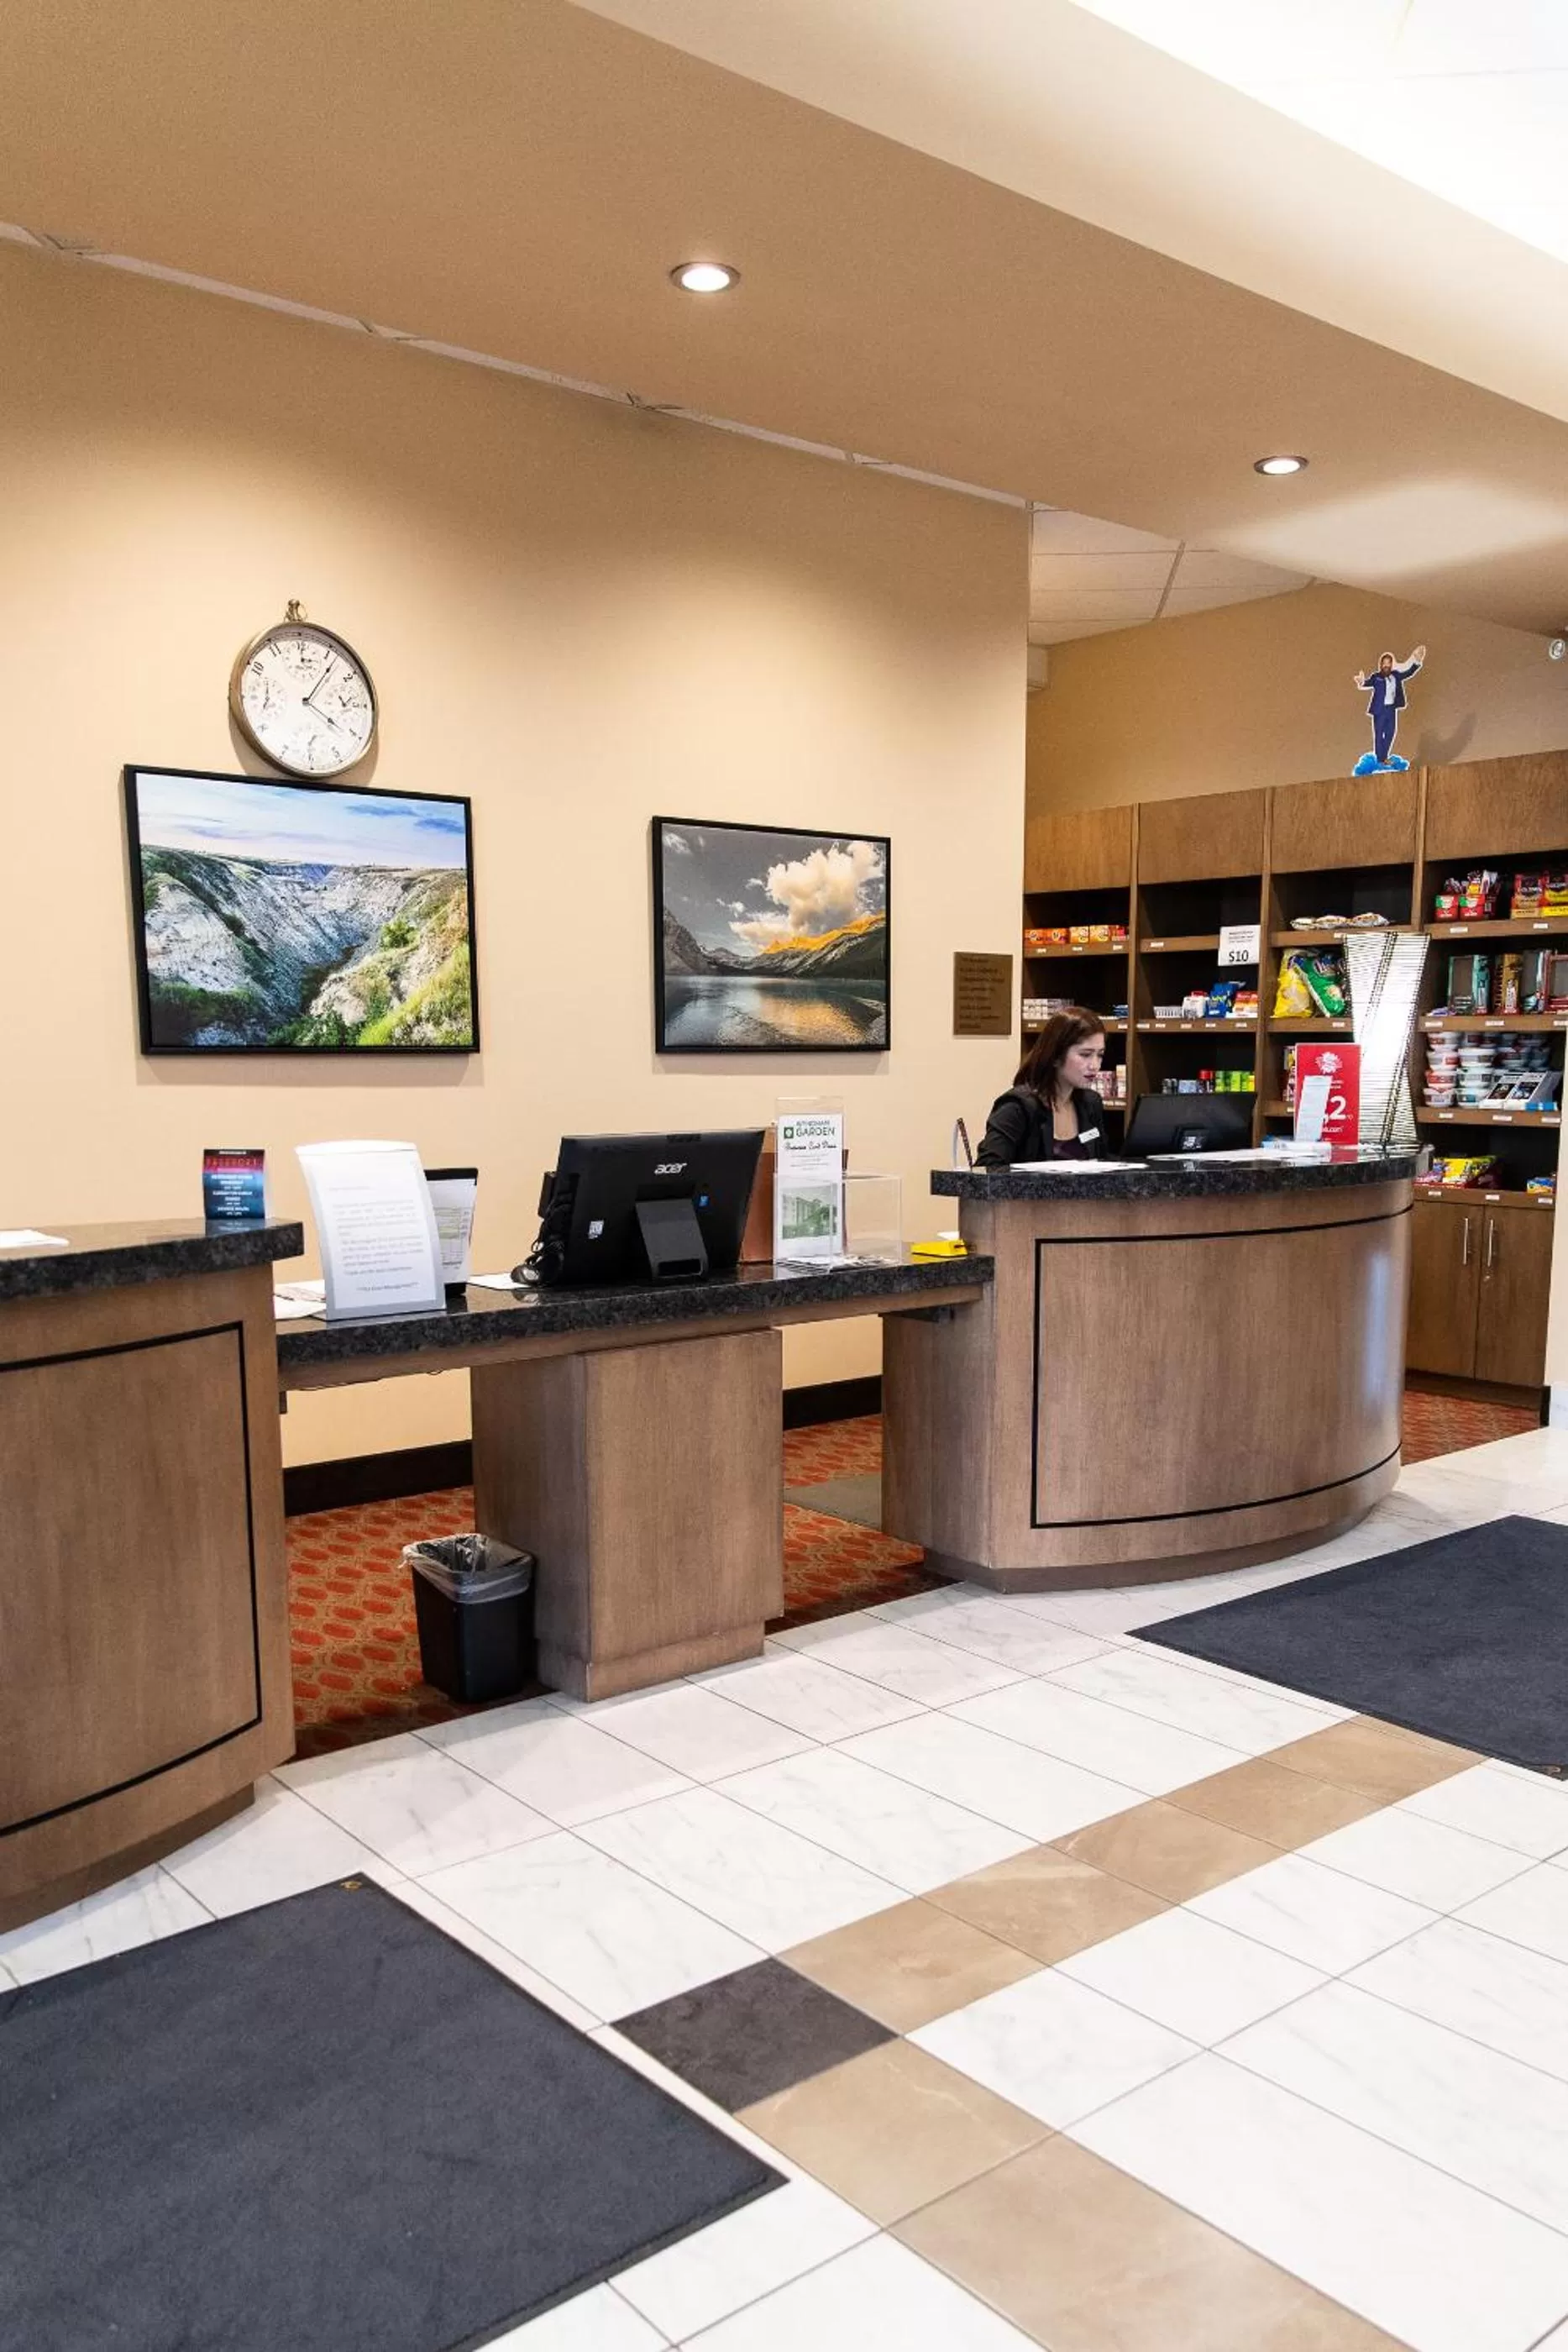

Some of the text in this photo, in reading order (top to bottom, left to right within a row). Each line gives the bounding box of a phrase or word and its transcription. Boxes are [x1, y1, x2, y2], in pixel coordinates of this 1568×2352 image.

[269, 642, 281, 657] 11
[323, 650, 330, 659] 1
[251, 661, 265, 676] 10
[343, 673, 353, 683] 2
[796, 1126, 835, 1137] GARDEN
[654, 1163, 688, 1174] acer
